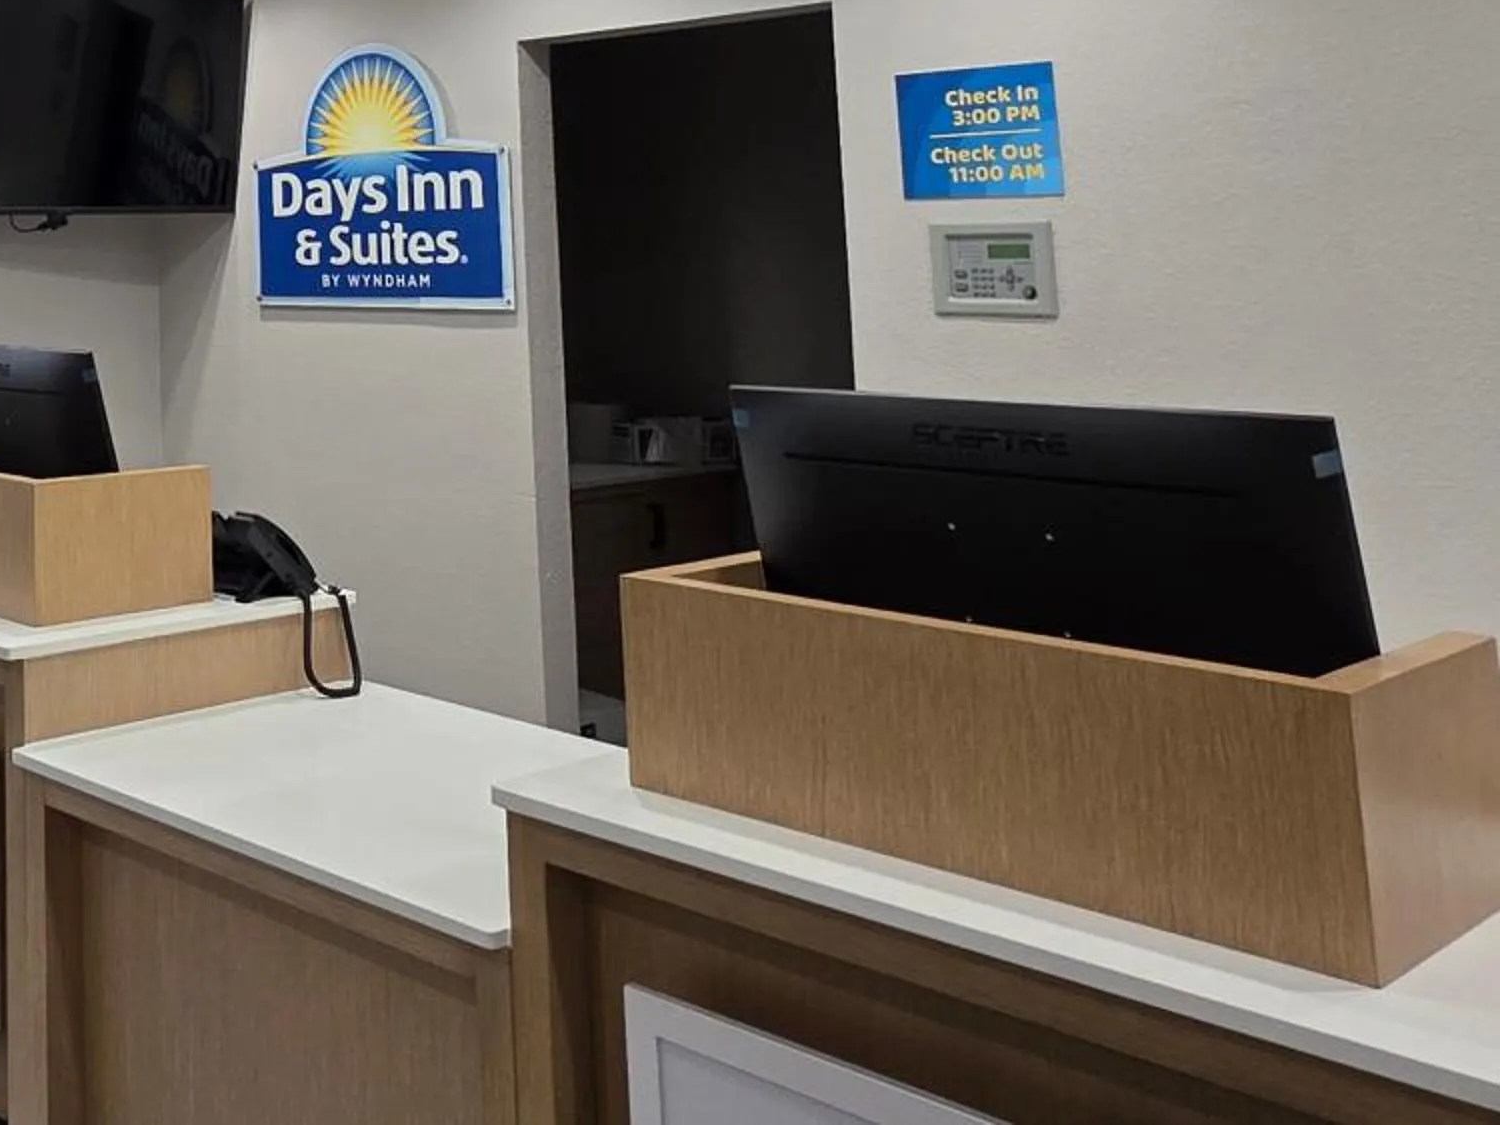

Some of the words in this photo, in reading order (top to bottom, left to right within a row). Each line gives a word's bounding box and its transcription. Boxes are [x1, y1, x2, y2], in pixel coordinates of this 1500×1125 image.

[945, 85, 1011, 107] Check
[1017, 85, 1038, 102] In
[952, 107, 1001, 126] 3:00
[1006, 105, 1041, 122] PM
[930, 145, 996, 164] Check
[1002, 143, 1044, 161] Out
[948, 165, 1004, 183] 11:00
[1009, 163, 1045, 180] AM
[271, 171, 388, 222] Days
[395, 164, 485, 212] Inn
[295, 228, 322, 266] &
[321, 274, 339, 288] BY
[347, 273, 432, 288] WYNDHAM
[911, 422, 1071, 457] SCEPTRE
